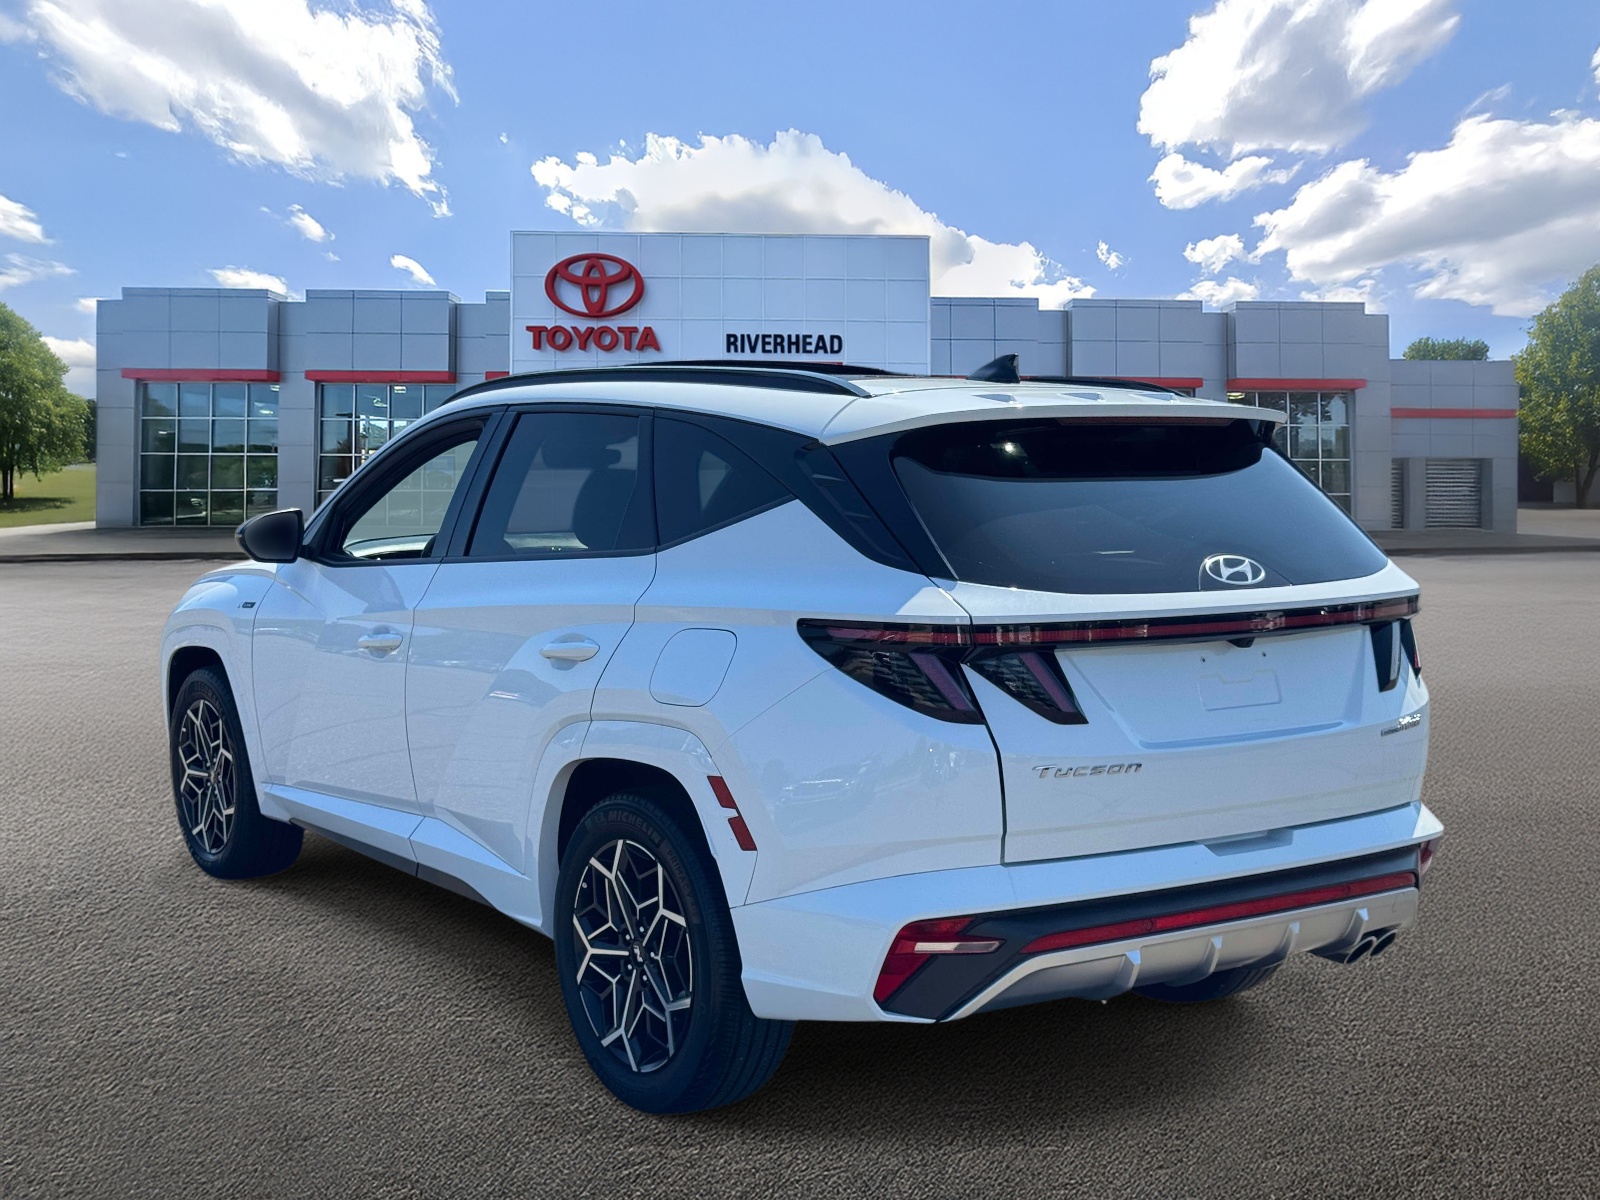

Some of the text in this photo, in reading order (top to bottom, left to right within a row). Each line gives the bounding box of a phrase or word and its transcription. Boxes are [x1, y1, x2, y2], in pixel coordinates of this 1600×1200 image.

[525, 325, 661, 352] TOYOTA
[726, 333, 843, 355] RIVERHEAD
[608, 810, 694, 901] MICHELIN PRIMACY
